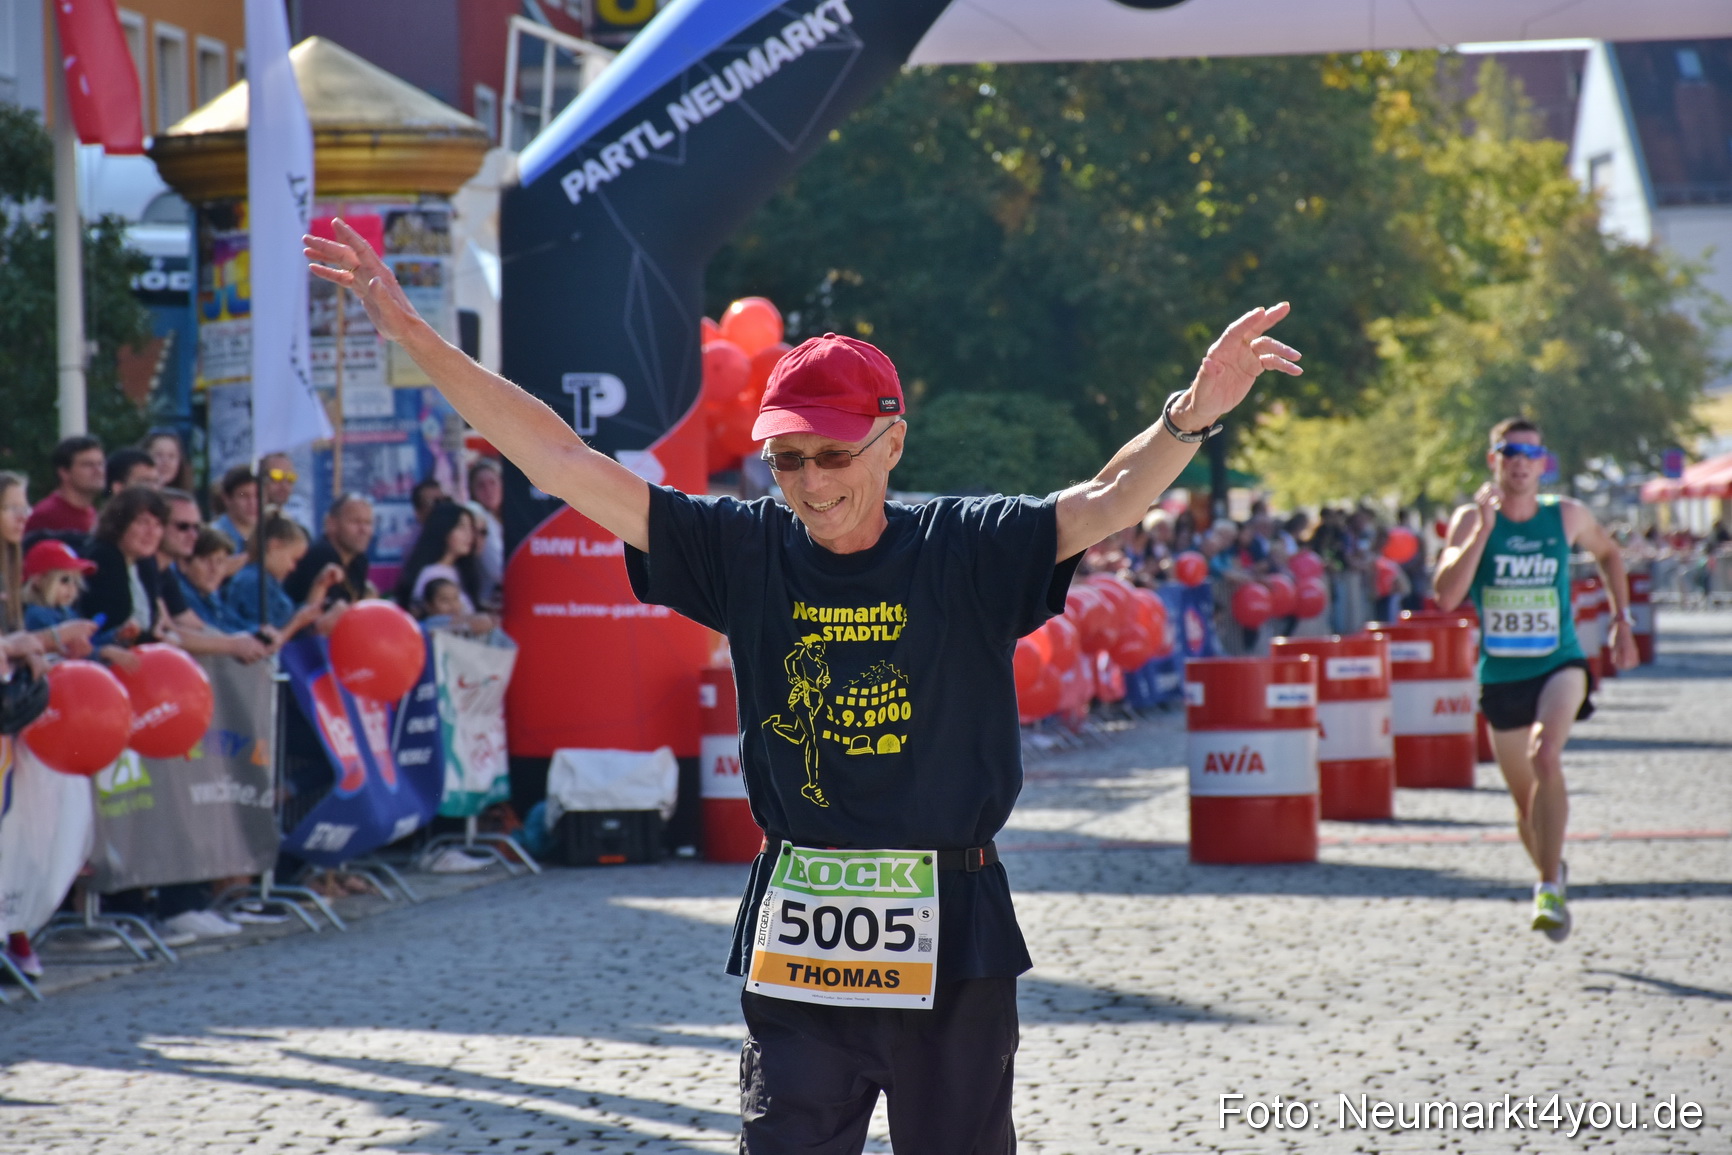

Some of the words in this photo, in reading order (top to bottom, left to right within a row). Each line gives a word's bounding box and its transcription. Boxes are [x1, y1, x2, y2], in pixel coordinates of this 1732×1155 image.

[560, 120, 675, 205] PARTL
[666, 0, 853, 132] NEUMARKT
[530, 537, 575, 556] BMW
[1491, 612, 1550, 632] 2835
[784, 853, 921, 893] BOCK
[778, 899, 916, 952] 5005
[922, 910, 930, 918] S
[787, 962, 900, 988] THOMAS
